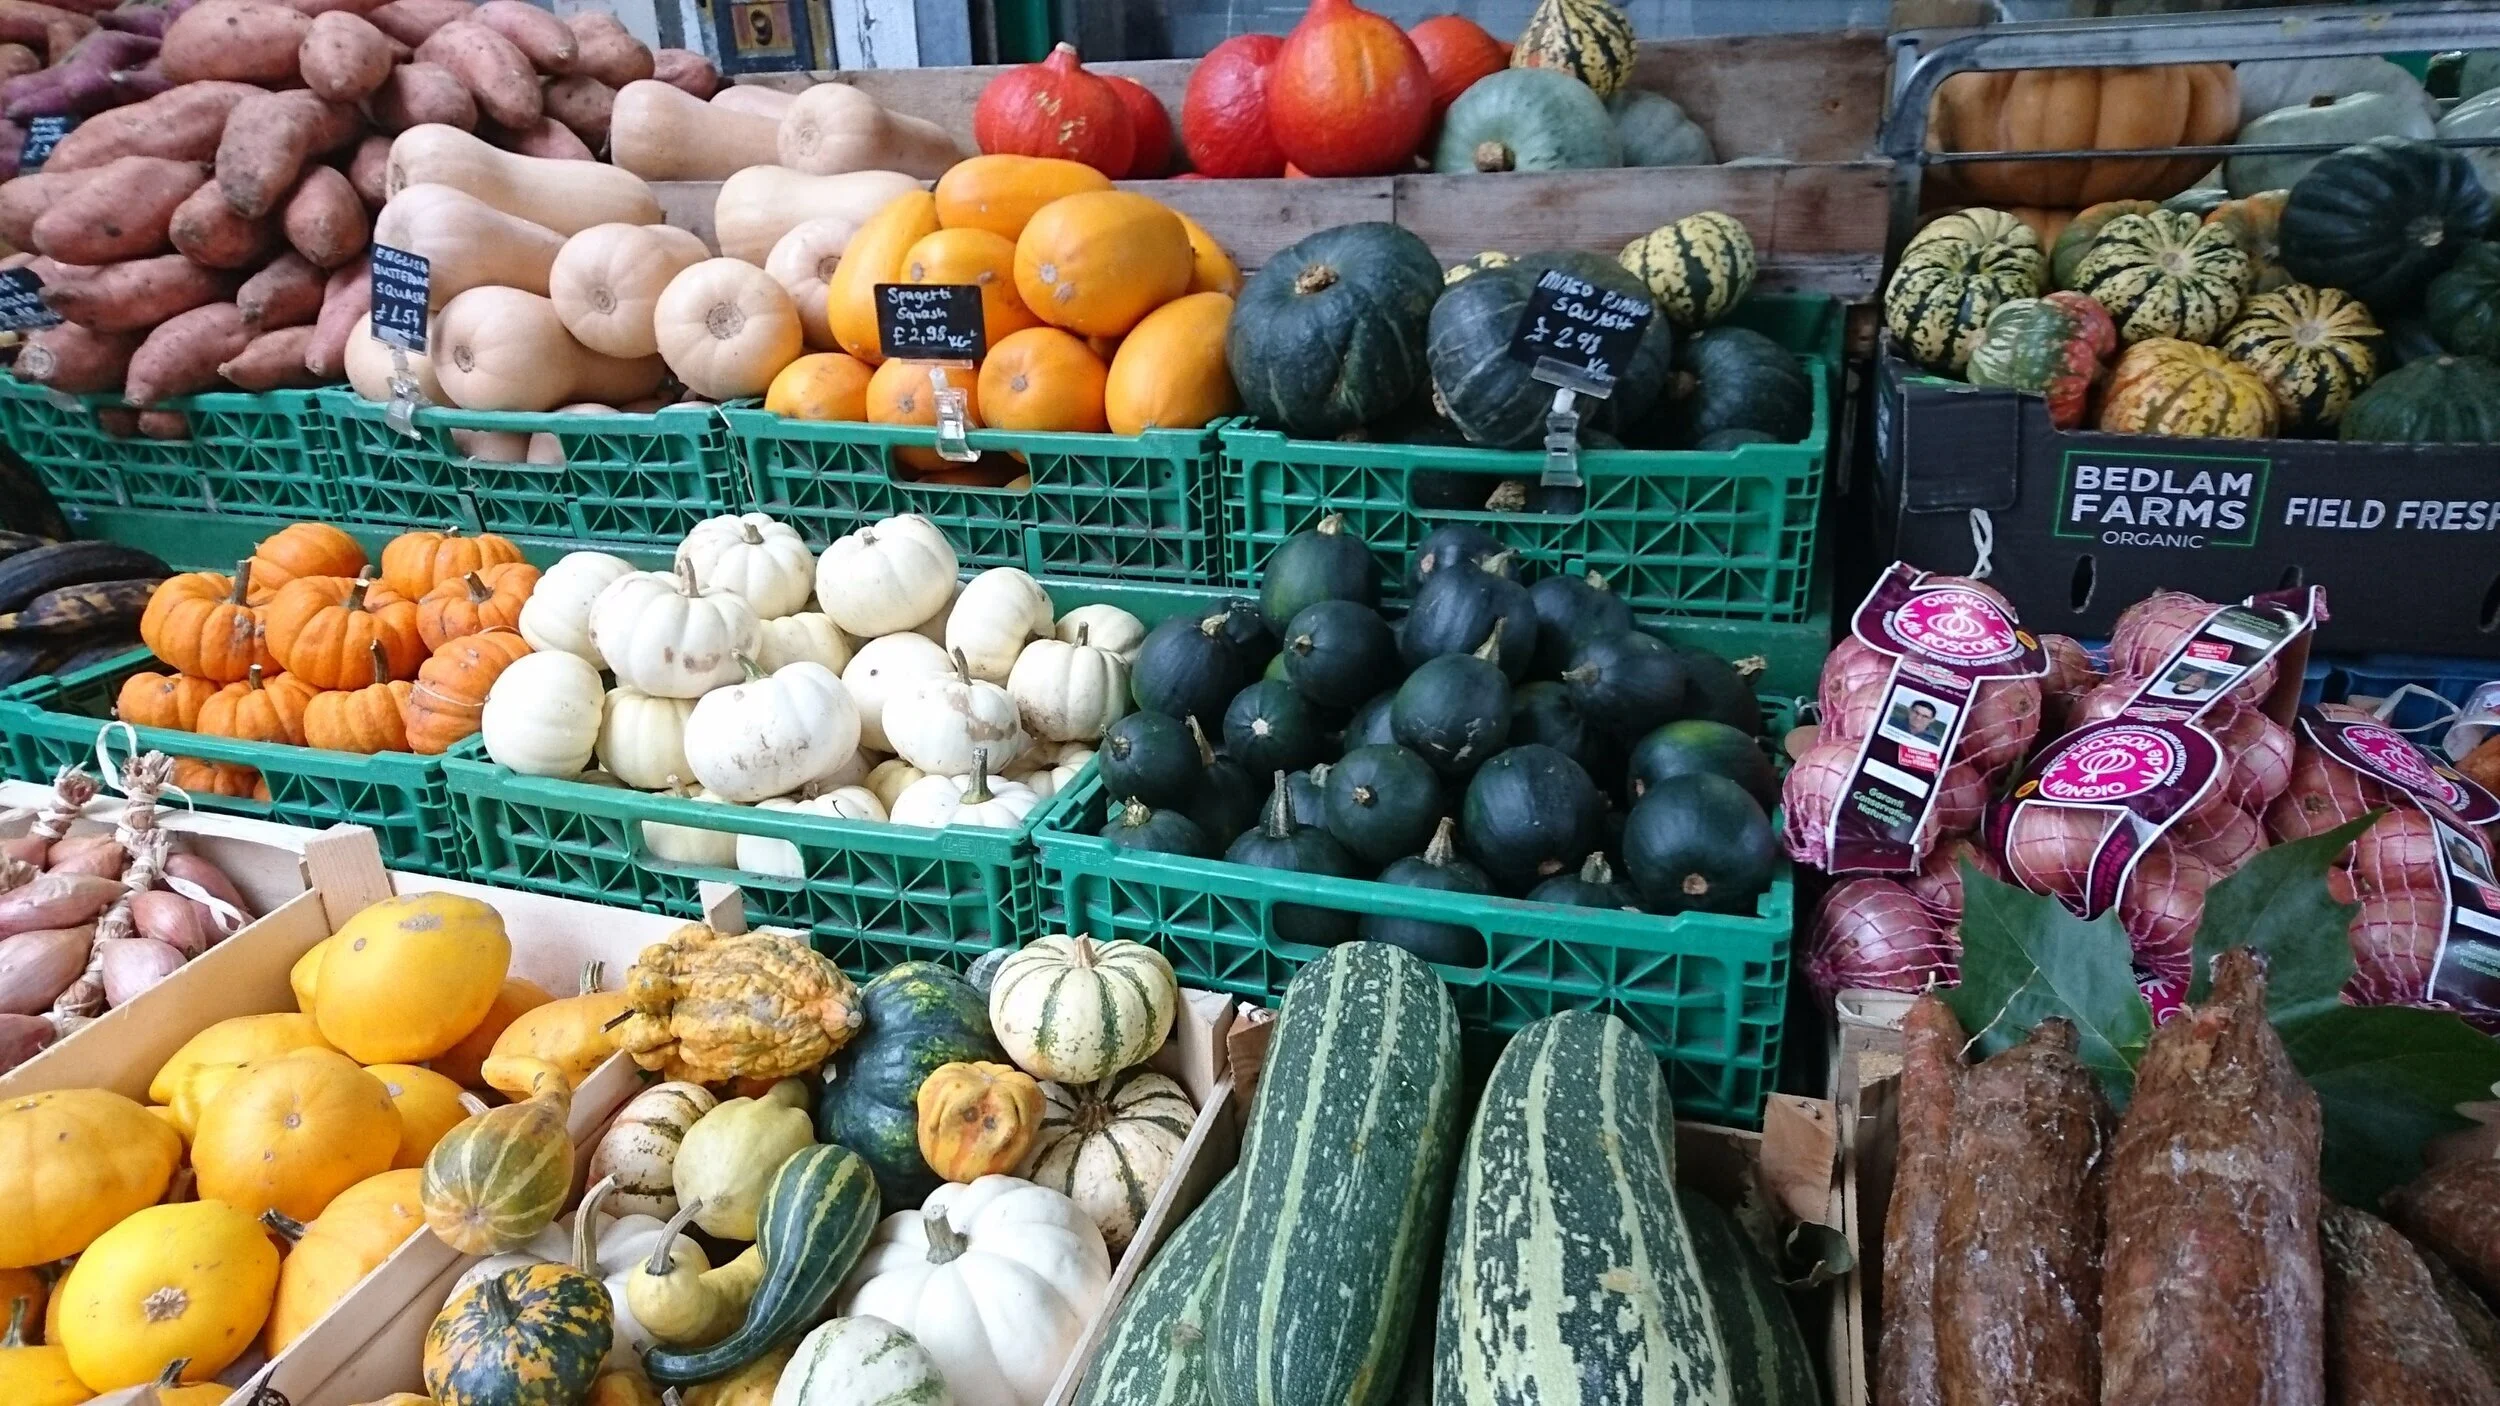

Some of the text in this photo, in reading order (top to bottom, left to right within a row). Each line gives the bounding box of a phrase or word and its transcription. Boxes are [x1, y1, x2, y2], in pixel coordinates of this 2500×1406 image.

[375, 246, 428, 274] ENGLISH
[376, 281, 427, 306] SQUASH
[1538, 270, 1594, 297] MIXED
[896, 306, 947, 325] Squash
[1552, 296, 1635, 331] SQUASH
[2074, 465, 2253, 497] BEDLAM
[2070, 494, 2247, 531] FARMS
[2284, 497, 2386, 530] FIELD
[2102, 530, 2204, 550] ORGANIC
[1922, 593, 2000, 621] OIGNON
[1902, 620, 1923, 635] de
[1918, 632, 2004, 655] ROSCOFF
[2069, 734, 2164, 767] de ROSCOFF
[1868, 787, 1905, 809] Garanti
[2047, 778, 2126, 798] OIGNON
[1852, 790, 1914, 823] Conservation
[1857, 802, 1901, 828] Naturelle
